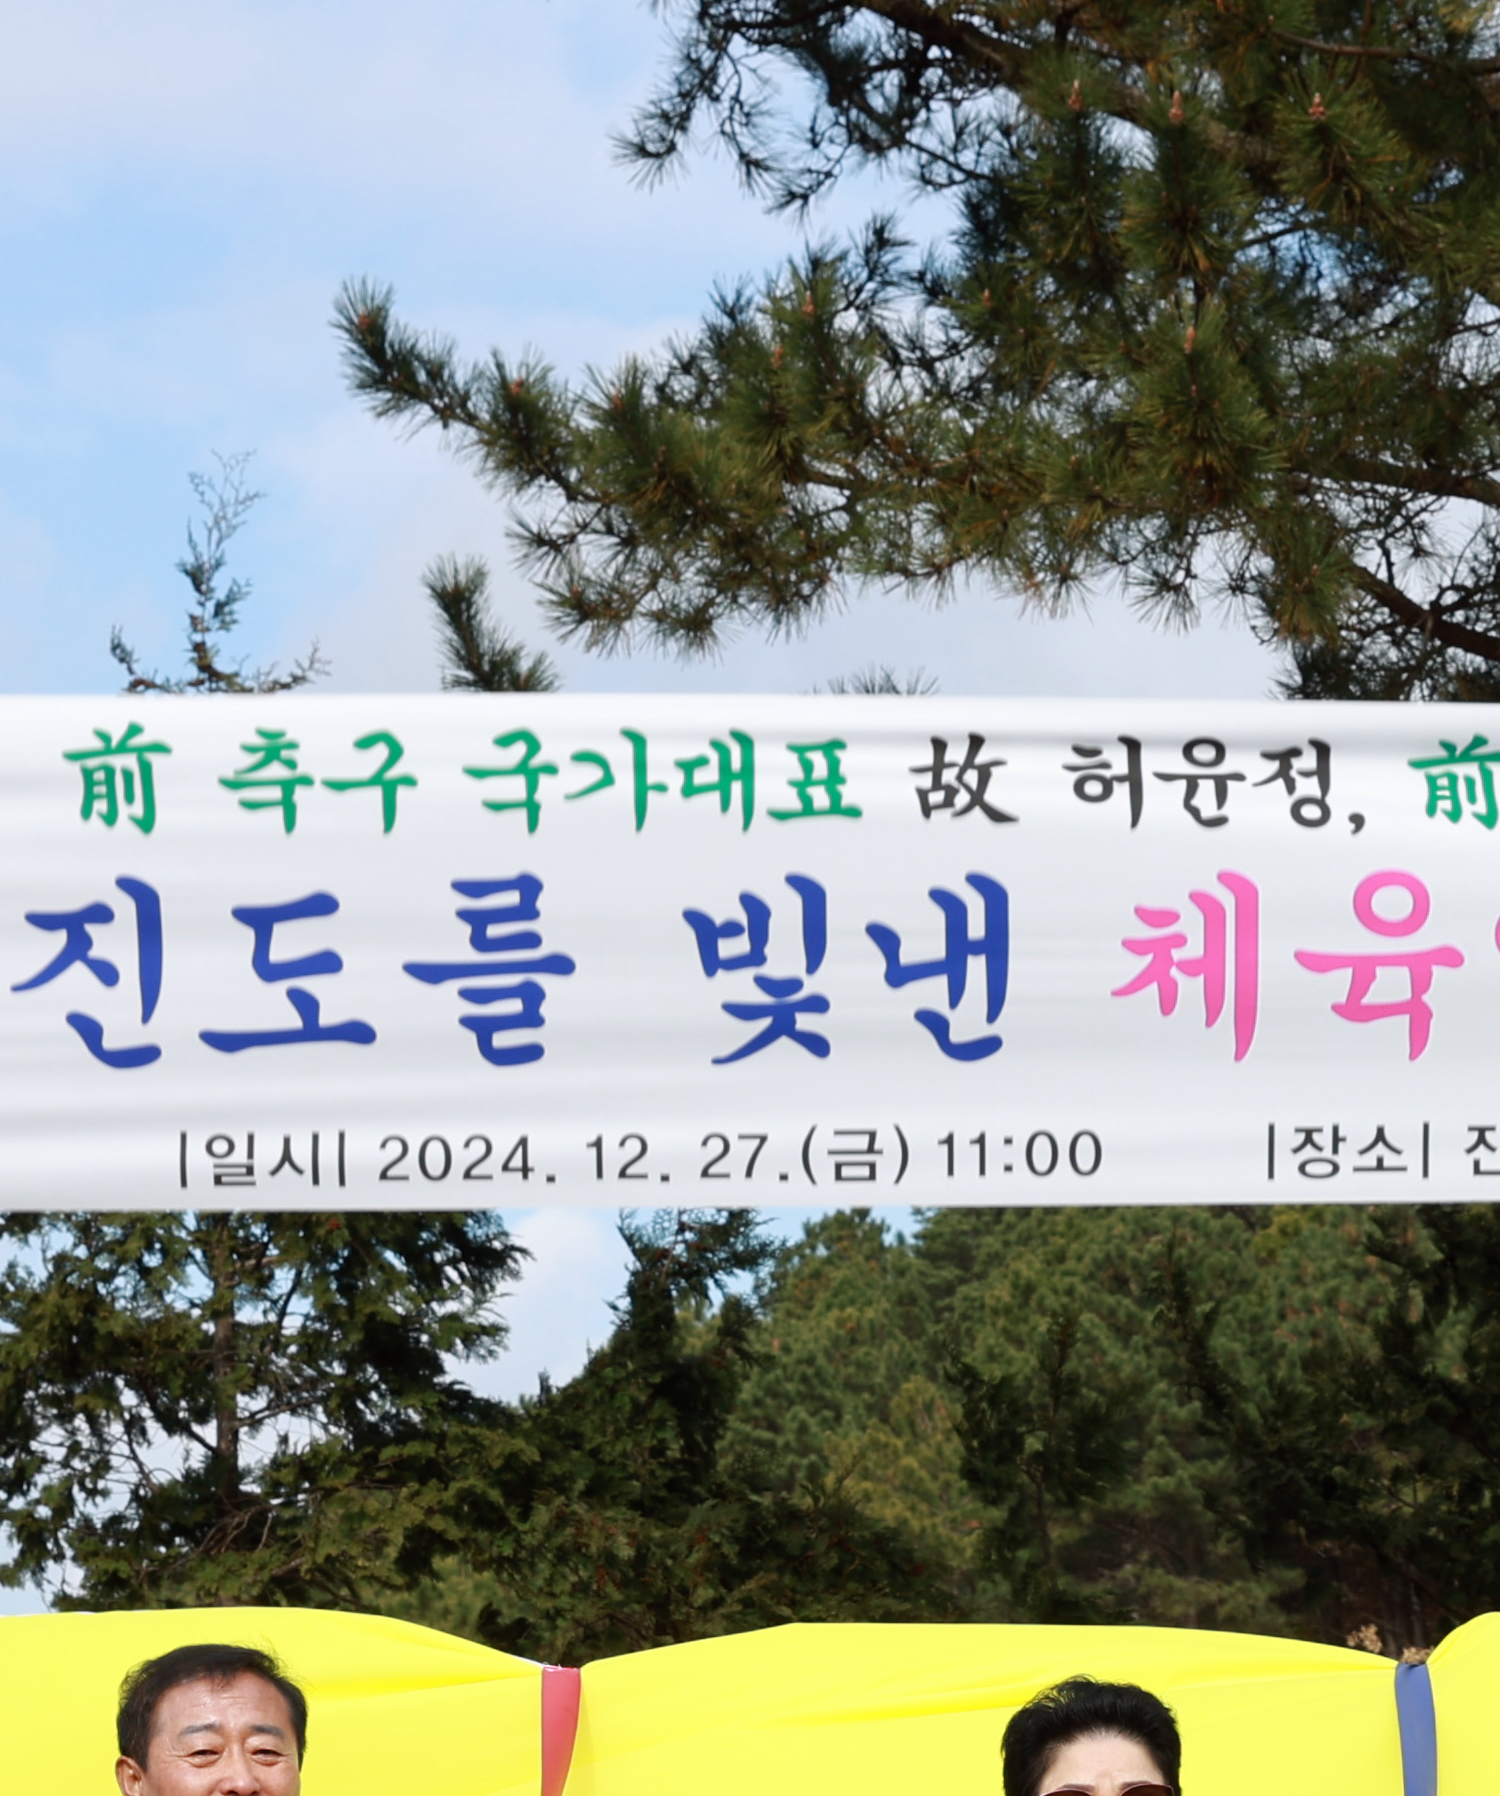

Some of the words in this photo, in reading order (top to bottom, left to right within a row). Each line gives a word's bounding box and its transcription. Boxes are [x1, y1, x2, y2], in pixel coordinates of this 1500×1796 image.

[62, 722, 173, 836] 前
[218, 728, 419, 835] 축구
[462, 728, 864, 835] 국가대표
[910, 731, 1017, 825] 故
[1063, 734, 1366, 835] 허윤정,
[10, 872, 577, 1071] 진도를
[681, 872, 1011, 1066] 빛낸
[378, 1134, 557, 1184] 2024.
[586, 1133, 671, 1183] 12.
[937, 1129, 1103, 1178] 11:00
